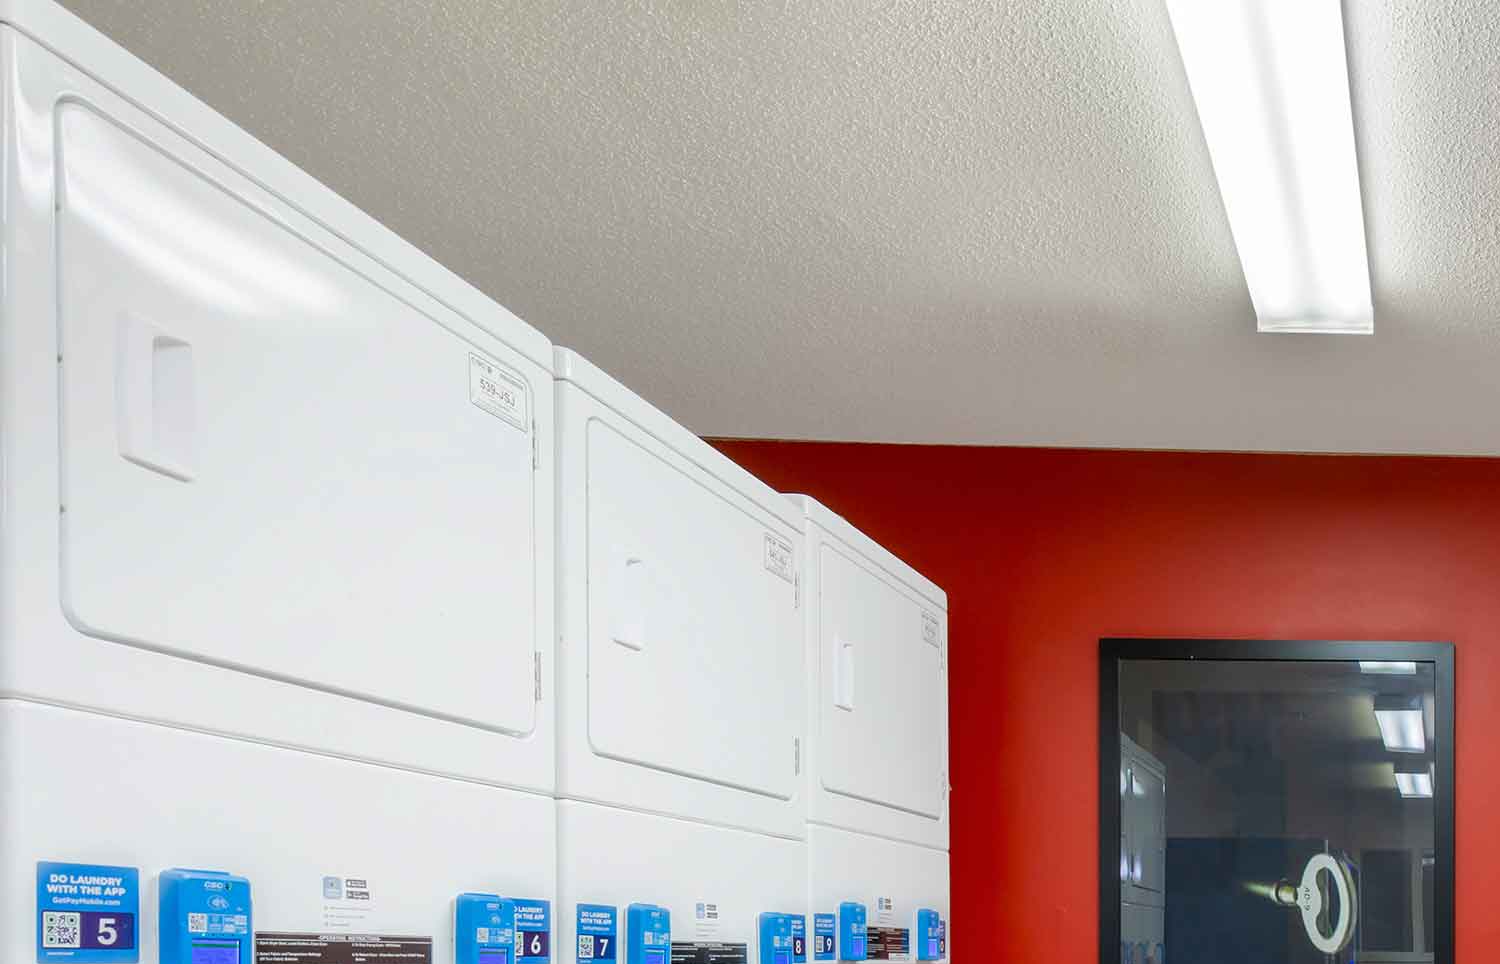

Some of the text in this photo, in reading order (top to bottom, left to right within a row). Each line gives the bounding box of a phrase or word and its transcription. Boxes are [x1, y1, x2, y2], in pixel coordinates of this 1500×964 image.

[50, 874, 122, 886] DO LAUNDRY
[47, 884, 126, 897] WITH THE APP
[97, 917, 117, 945] 5
[531, 934, 541, 954] 6
[599, 938, 608, 957] 7
[795, 940, 802, 954] 8
[826, 937, 832, 951] 9
